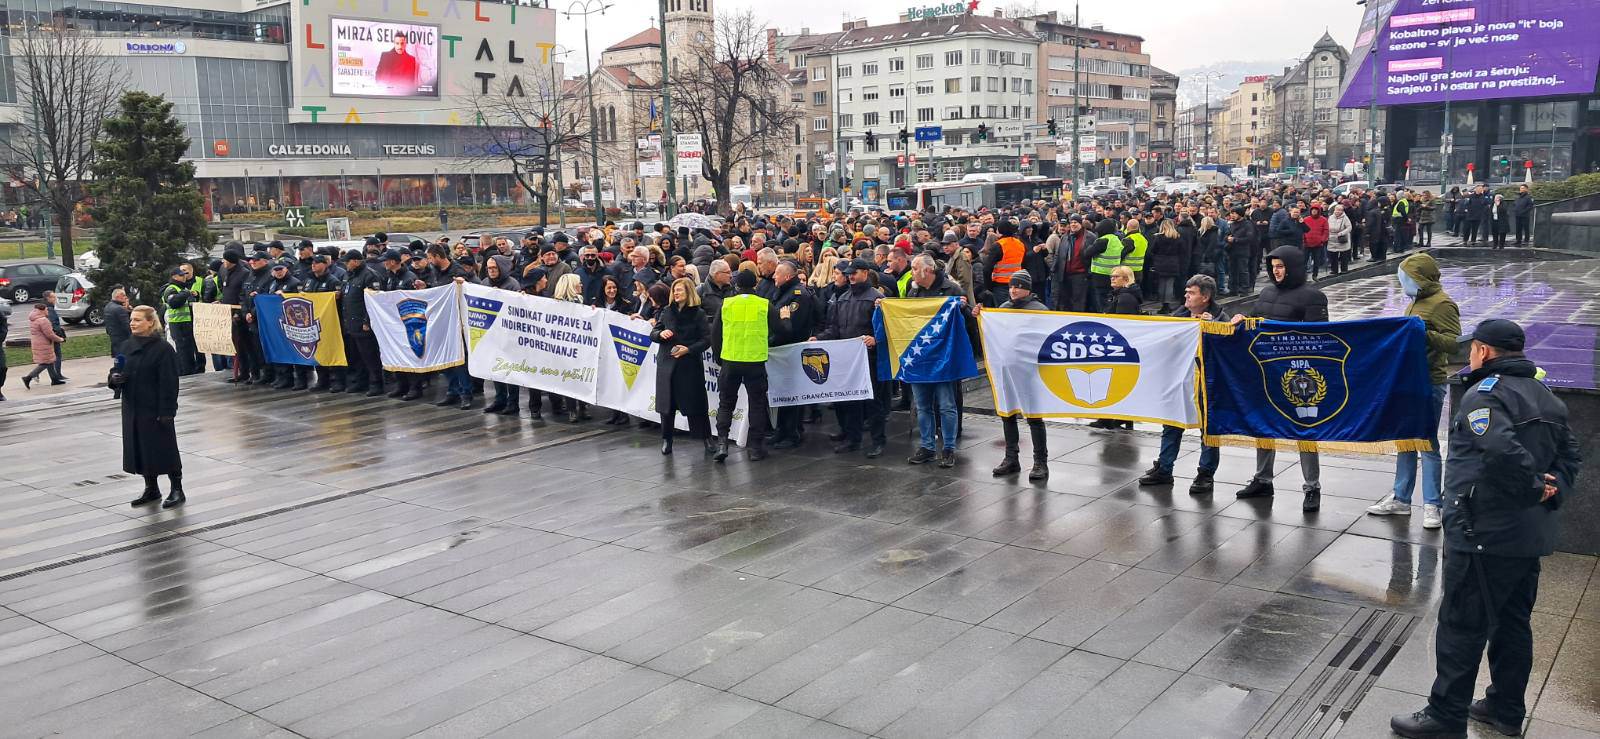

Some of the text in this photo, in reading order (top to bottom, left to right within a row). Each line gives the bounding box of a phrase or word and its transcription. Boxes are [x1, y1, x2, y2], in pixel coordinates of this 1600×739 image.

[907, 2, 964, 19] Heineken
[337, 25, 433, 46] MIRZA SELOVIĆ
[1390, 28, 1439, 39] Kobaltno
[1441, 26, 1472, 37] plava
[1473, 23, 1485, 34] je
[1488, 22, 1516, 31] nova
[1539, 19, 1564, 30] boja
[1389, 41, 1427, 51] sezone
[1454, 36, 1466, 47] je
[1468, 34, 1489, 44] već
[1491, 33, 1519, 42] nose
[1388, 72, 1428, 84] Najbolji
[1431, 69, 1472, 81] gradovi
[1490, 65, 1530, 76] šetnju:
[1387, 84, 1432, 95] Sarajevo
[1440, 81, 1479, 92] Mostar
[1482, 80, 1496, 89] na
[1498, 75, 1565, 89] prestižnoj...
[268, 144, 351, 155] CALZEDONIA
[383, 144, 435, 155] TEZENIS
[507, 305, 593, 331] SINDIKAT UPRAVE ZA
[501, 318, 598, 348] INDIREKTNO-NEIZRAVNO
[518, 336, 578, 358] OPOREZIVANJE
[1050, 342, 1126, 360] SDSZ
[492, 358, 537, 376] Zajedno
[540, 366, 560, 376] smo
[1291, 360, 1310, 369] SIPA
[772, 395, 799, 403] SINDIKAT
[801, 391, 833, 400] GRANIČNE
[834, 389, 860, 397] POLICIJE
